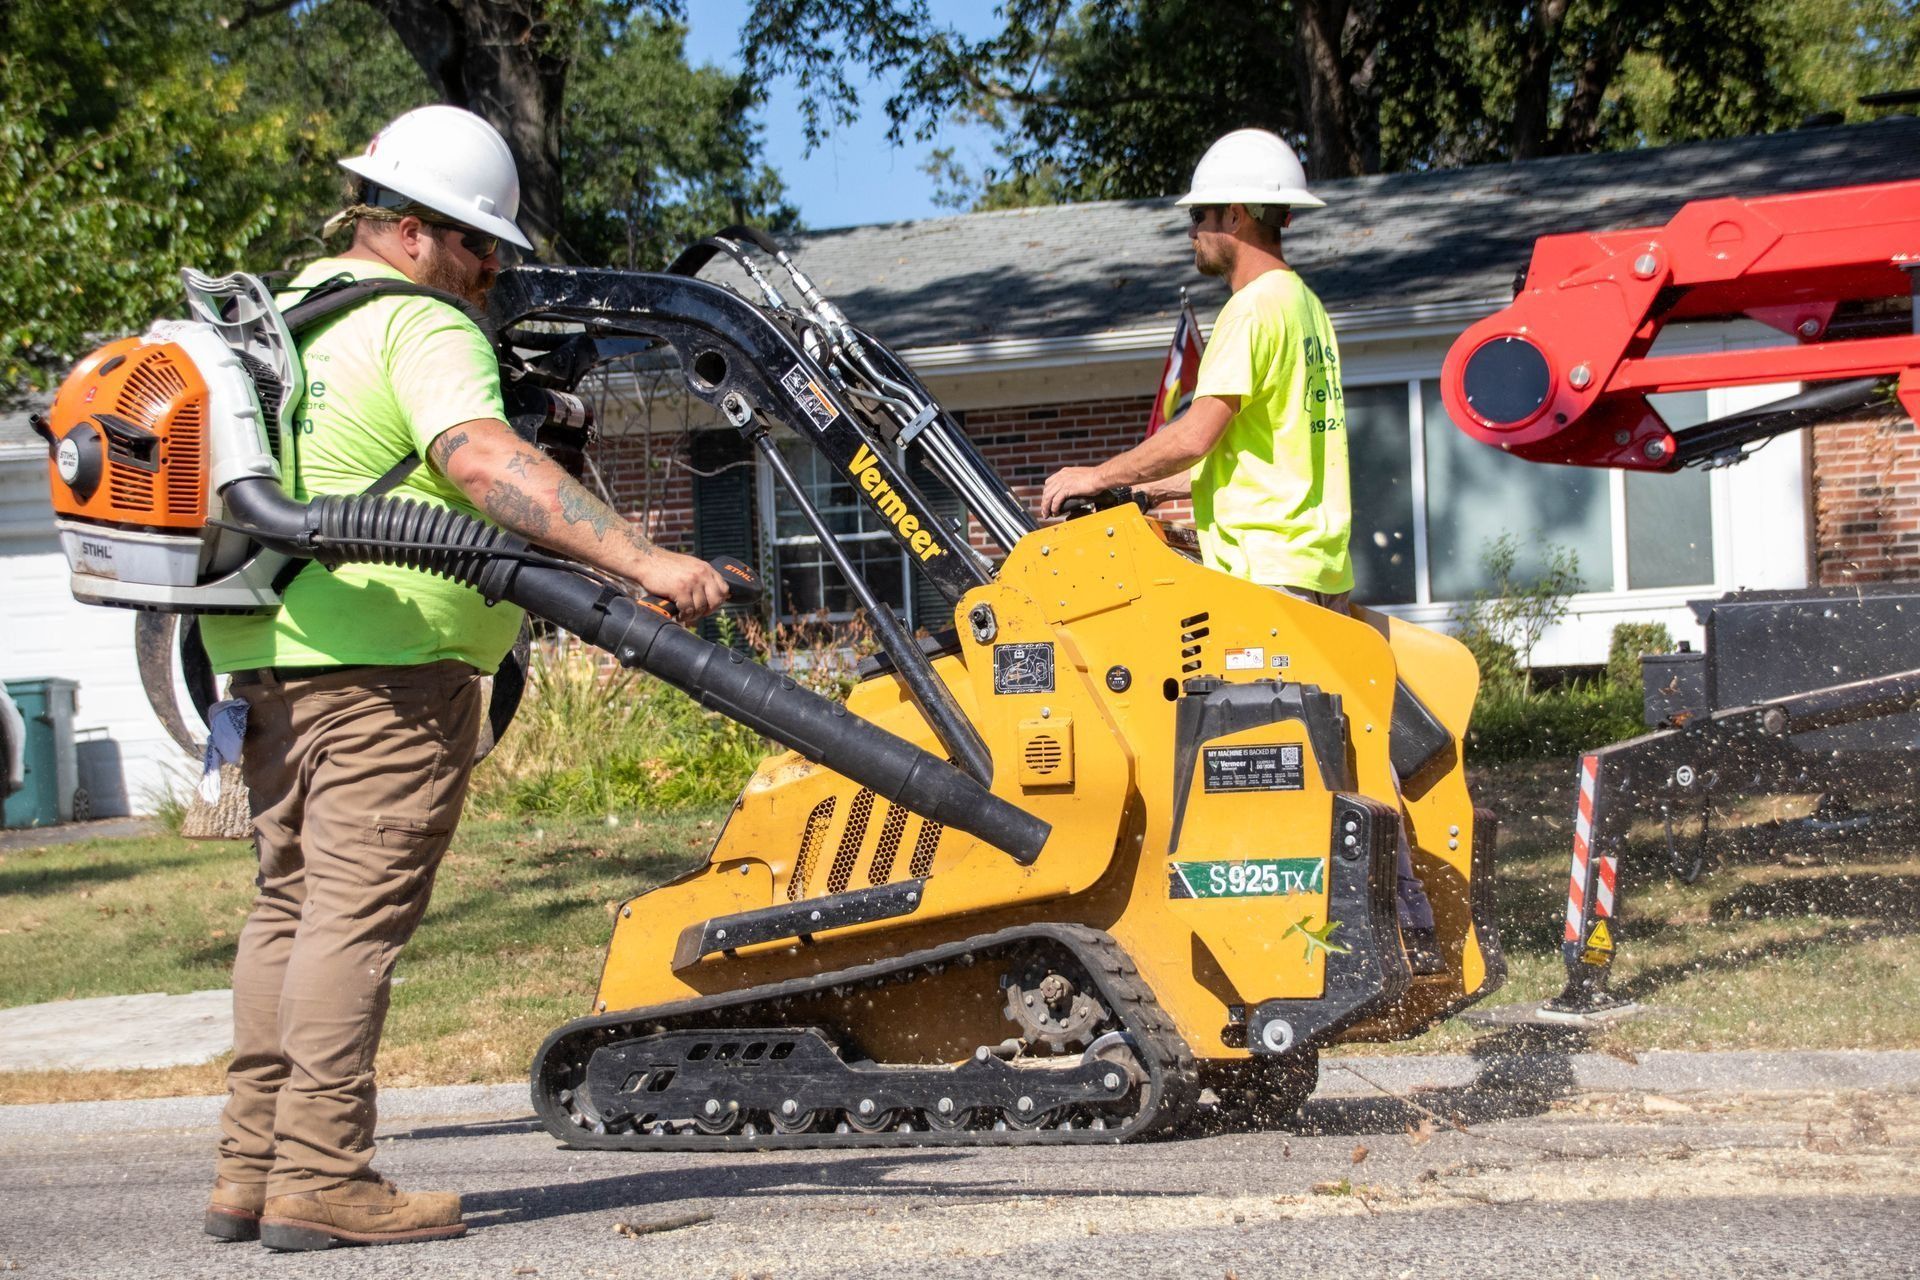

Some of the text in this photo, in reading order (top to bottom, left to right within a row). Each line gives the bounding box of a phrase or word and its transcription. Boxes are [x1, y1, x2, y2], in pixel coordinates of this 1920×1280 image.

[848, 442, 943, 562] Vermeer
[82, 541, 112, 559] STIHL
[1218, 749, 1242, 757] MACHINE
[1249, 748, 1269, 756] BACKED
[1220, 760, 1246, 768] Vermeer
